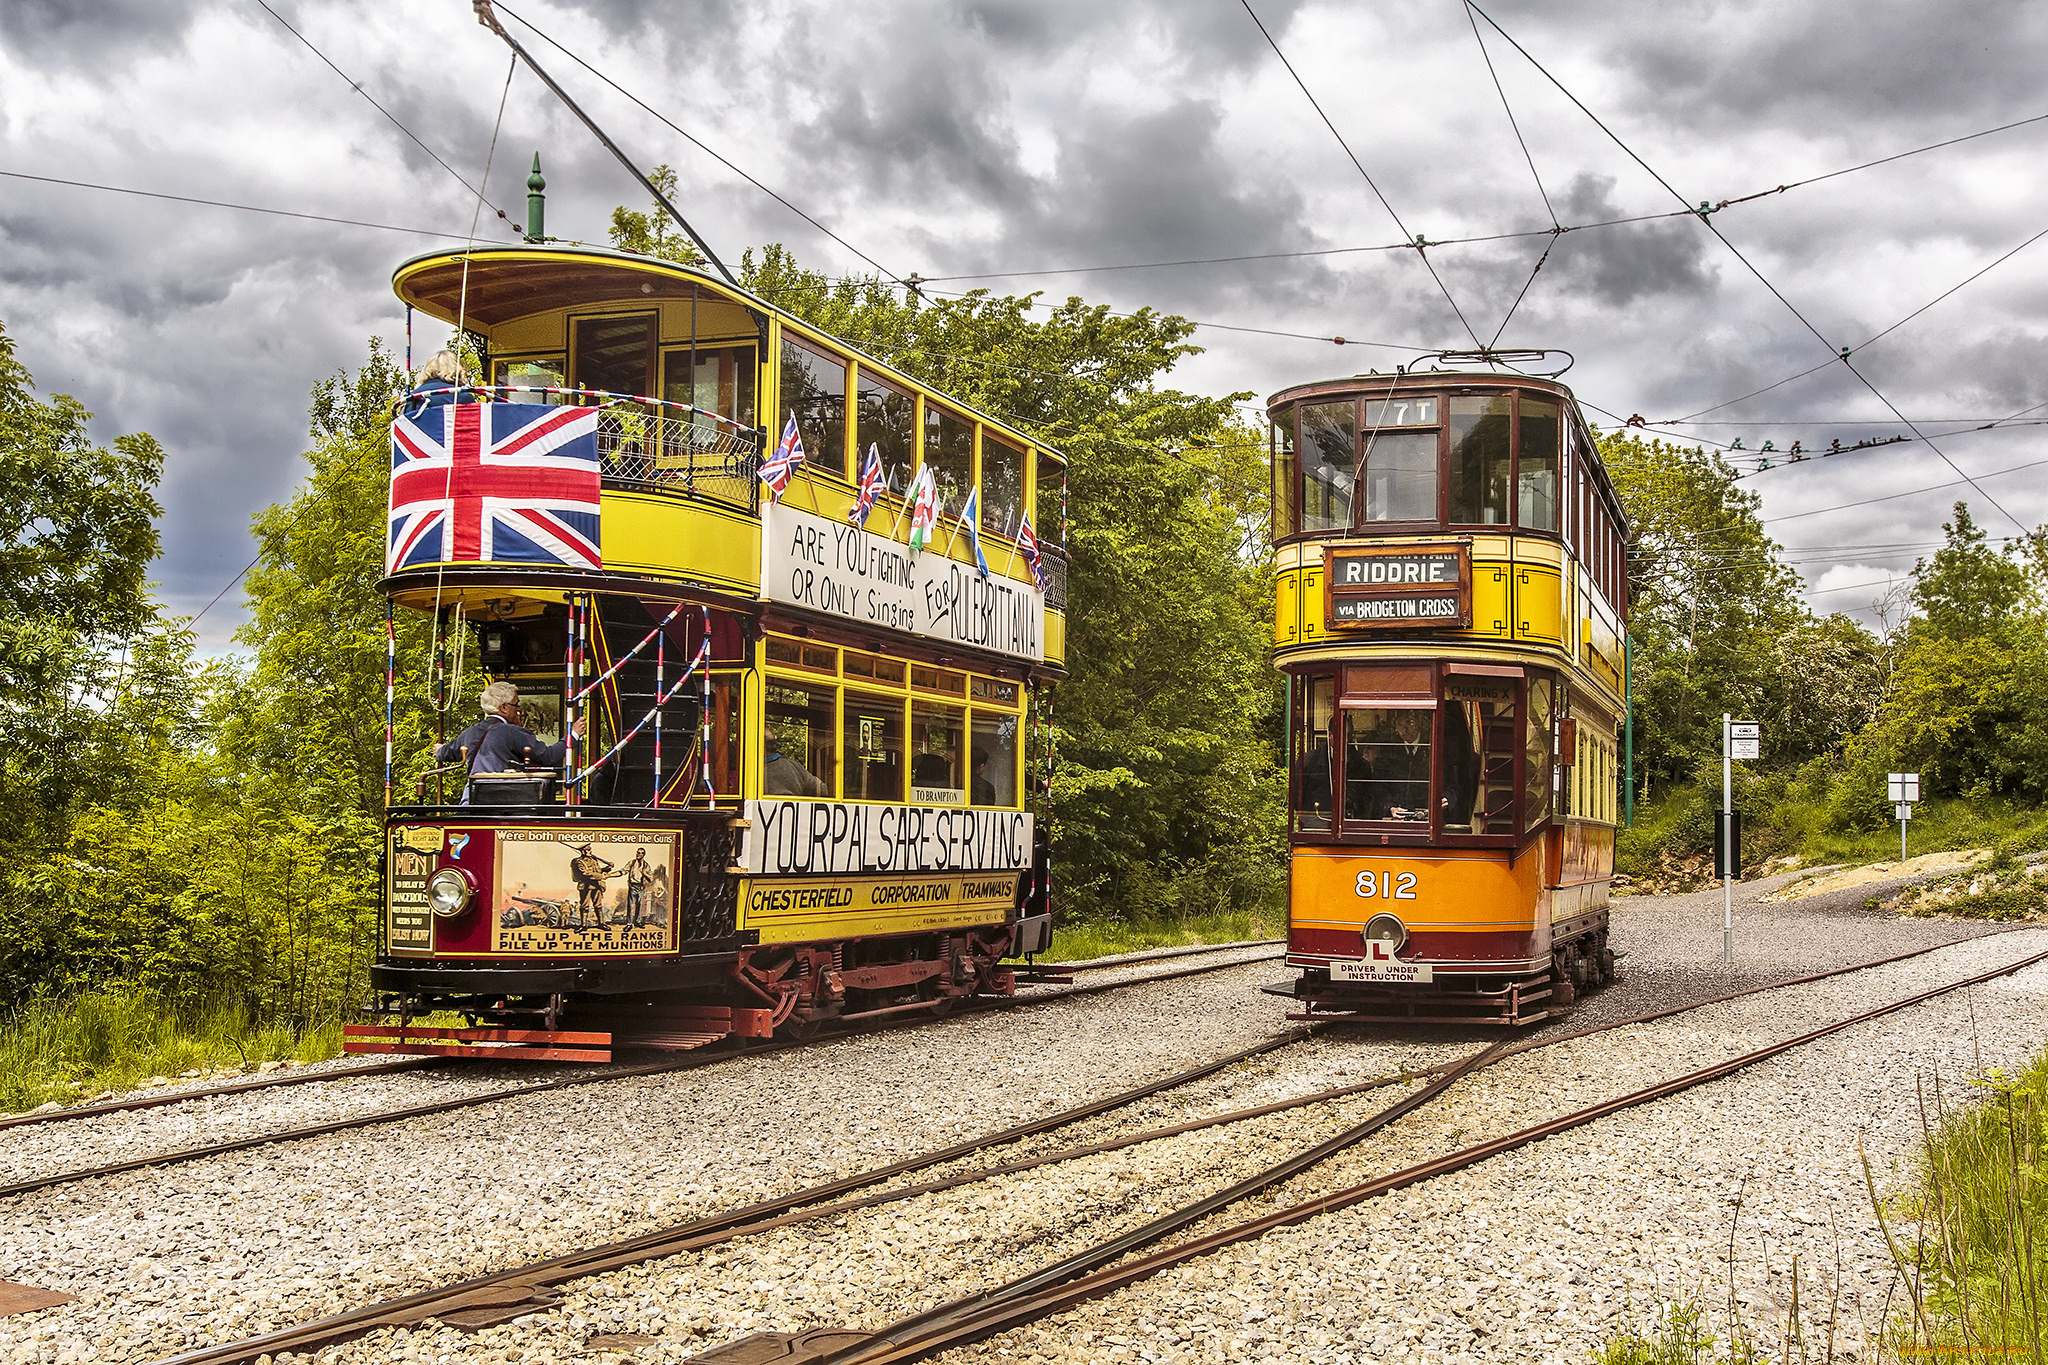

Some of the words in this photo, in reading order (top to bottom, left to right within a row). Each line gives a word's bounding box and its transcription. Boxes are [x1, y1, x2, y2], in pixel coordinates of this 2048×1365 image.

[791, 525, 826, 566] ARE
[832, 523, 868, 576] YOU
[869, 546, 916, 590] FIGHTING
[1346, 562, 1445, 583] RIDDRIE
[792, 568, 815, 606] OR
[821, 576, 860, 617] ONLY
[868, 588, 914, 631] Singing
[1339, 606, 1355, 616] VIA
[1357, 600, 1416, 619] BRIDGETON
[1419, 598, 1455, 616] CROSS
[1451, 686, 1498, 699] CHARING
[1501, 688, 1510, 699] X
[916, 789, 925, 801] TO
[925, 791, 958, 802] BRAMPTON
[528, 831, 554, 841] both
[557, 832, 596, 842] needed
[599, 832, 610, 842] to
[611, 834, 636, 843] serve
[638, 833, 652, 843] the
[758, 801, 828, 873] YOUR
[830, 804, 895, 872] PALS
[893, 807, 934, 871] ARE
[448, 833, 470, 860] 7
[395, 852, 428, 876] MEN
[1354, 870, 1418, 900] 812
[392, 892, 429, 903] DANGEROUS
[751, 887, 853, 912] CHESTERFIELD
[871, 883, 951, 905] CORPORATION
[962, 880, 1013, 898] TRAMWAYS
[411, 929, 430, 941] NOW
[499, 932, 538, 941] FILL
[545, 932, 570, 941] UP
[579, 932, 613, 941] THE
[621, 931, 668, 941] RANKS!
[499, 941, 530, 950] PILE
[537, 941, 558, 950] UP
[562, 941, 593, 950] THE
[598, 940, 668, 950] MUNITIONS!
[1372, 943, 1390, 961] L
[1340, 964, 1376, 973] DRIVER
[1386, 966, 1419, 974] UNDER
[1348, 973, 1414, 981] INSTRUCTION
